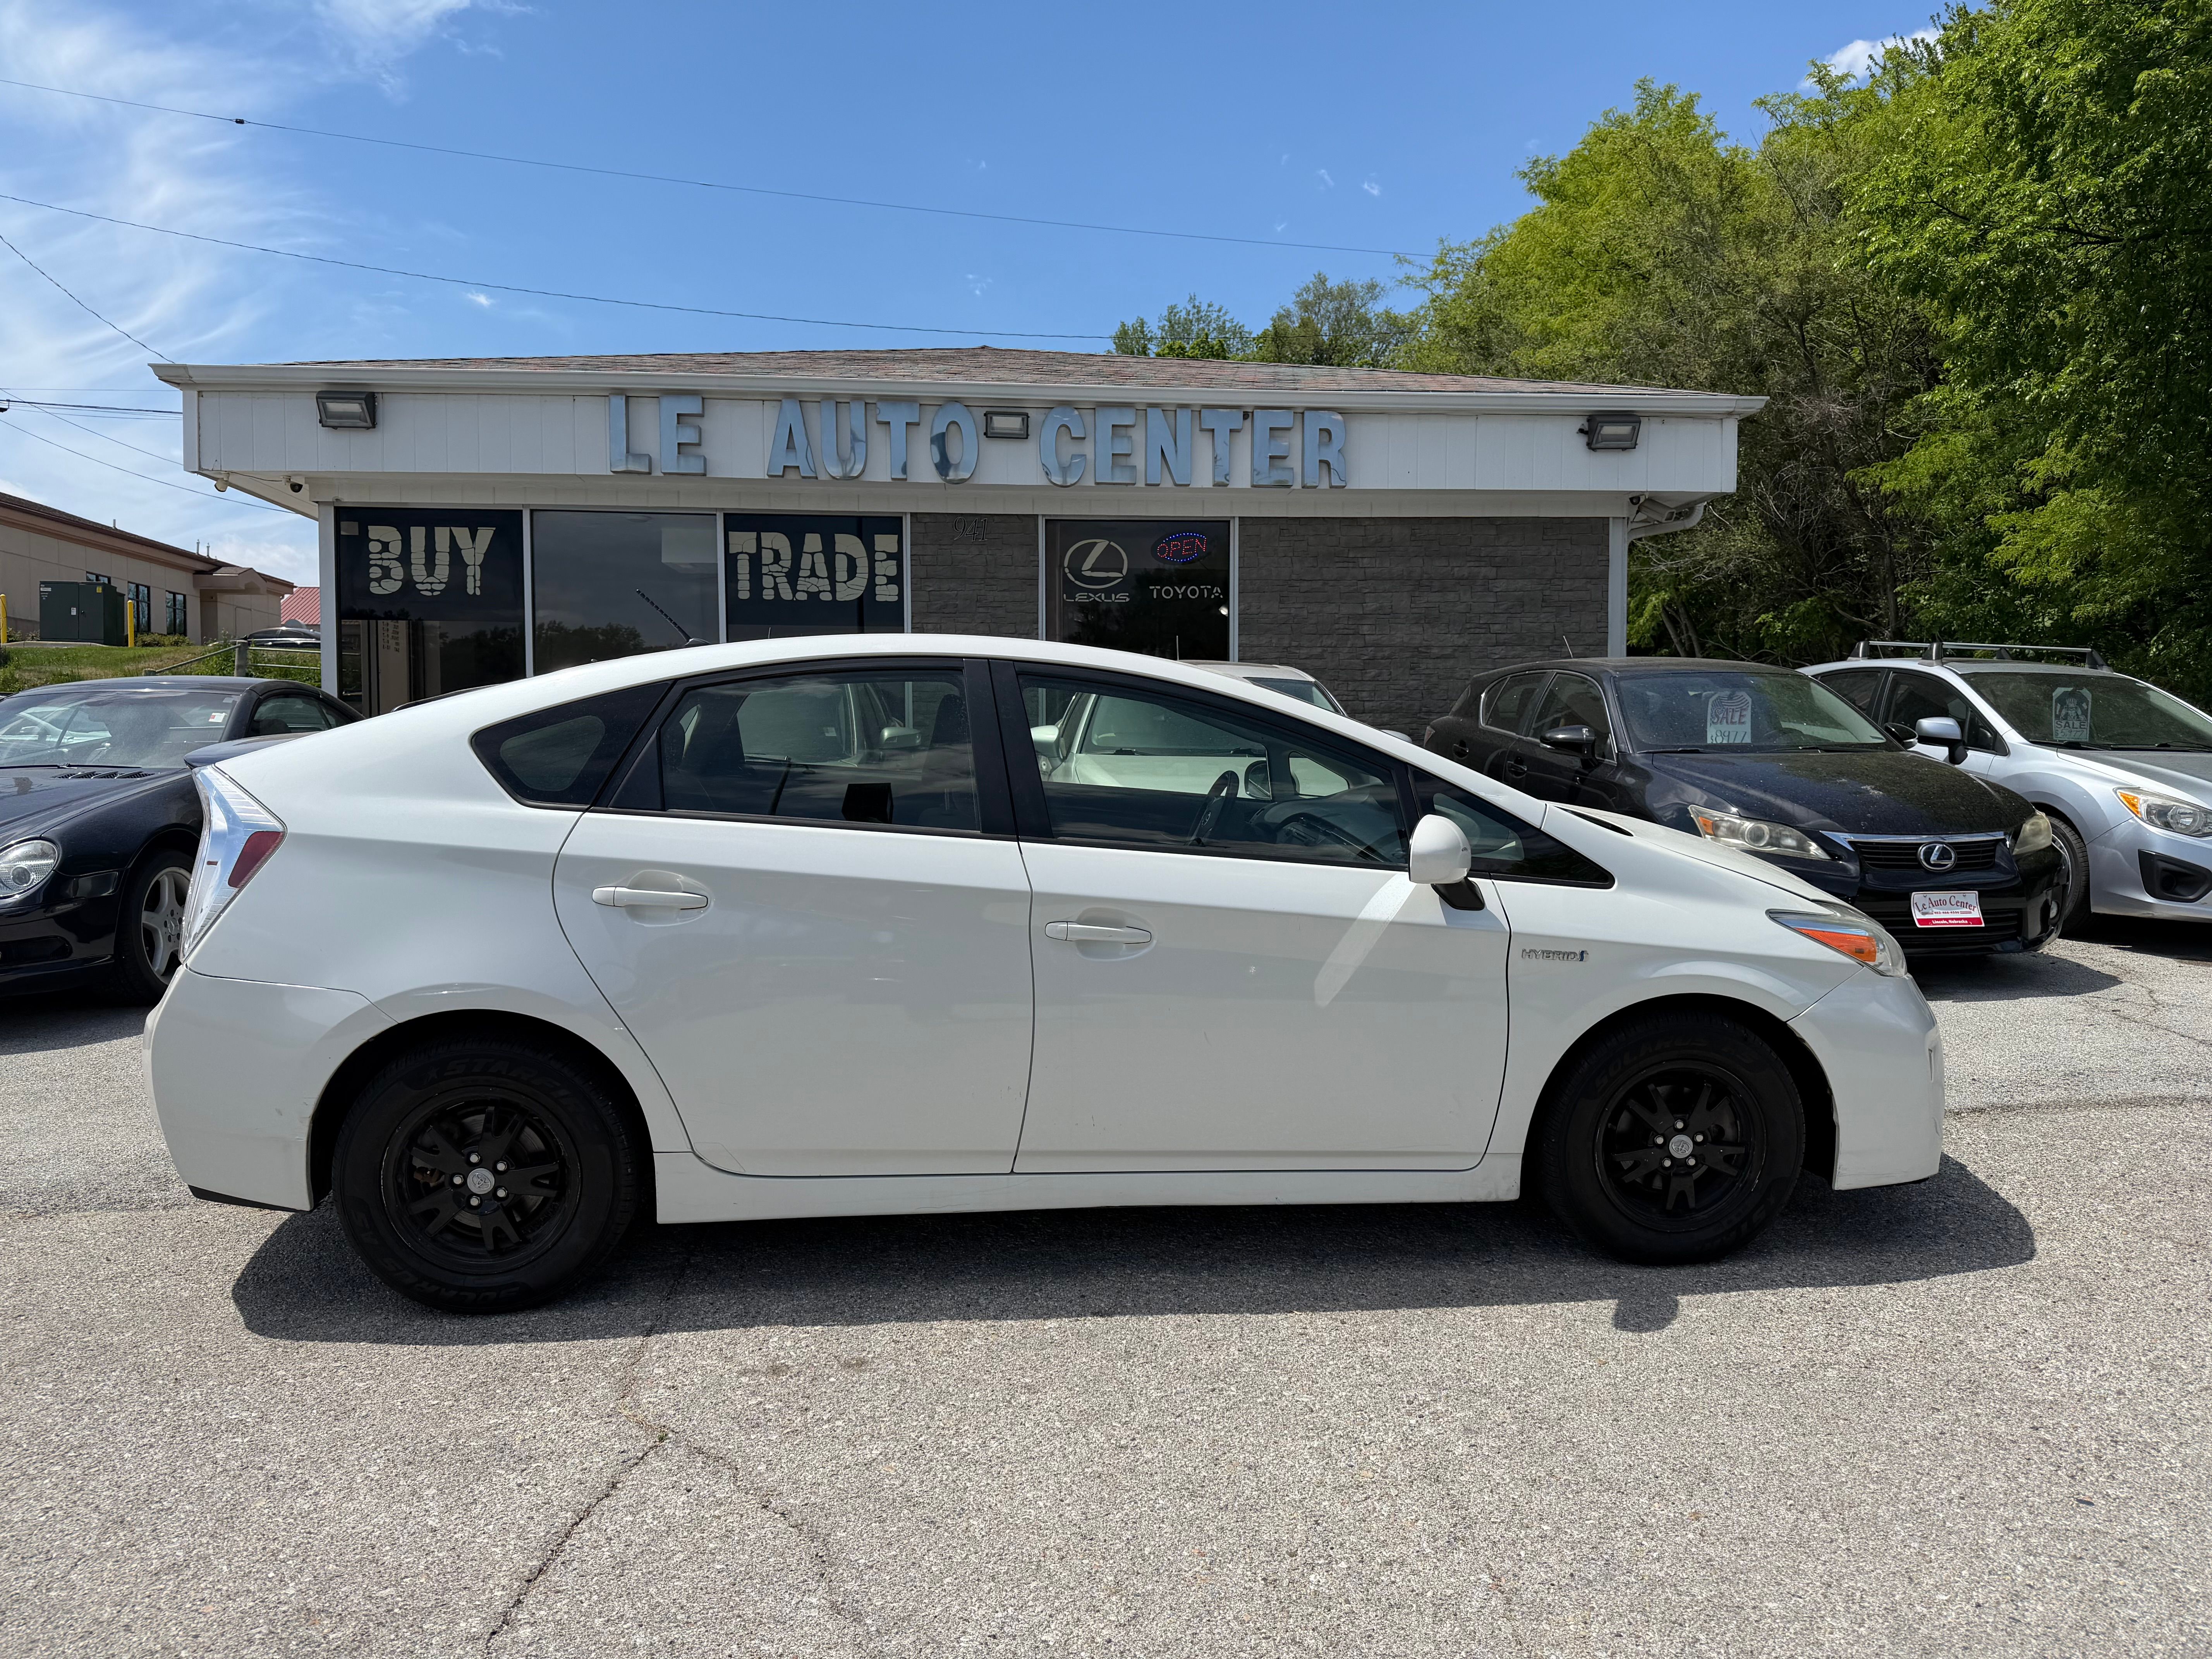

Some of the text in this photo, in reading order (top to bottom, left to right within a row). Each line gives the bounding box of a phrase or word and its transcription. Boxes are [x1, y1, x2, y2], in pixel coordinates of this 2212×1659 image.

[609, 393, 1346, 489] LE AUTO CENTER
[953, 516, 988, 542] 941
[1157, 537, 1207, 558] OPEN
[368, 526, 496, 596] BUY
[728, 531, 898, 601] TRADE
[1063, 592, 1130, 602] LEXUS
[1149, 586, 1223, 599] TOYOTA
[1712, 707, 1748, 725] SALE
[2056, 721, 2087, 729] SALE
[1711, 730, 1747, 743] $8977
[1915, 895, 1977, 912] Le Auto Center
[1522, 949, 1578, 961] HYBRID
